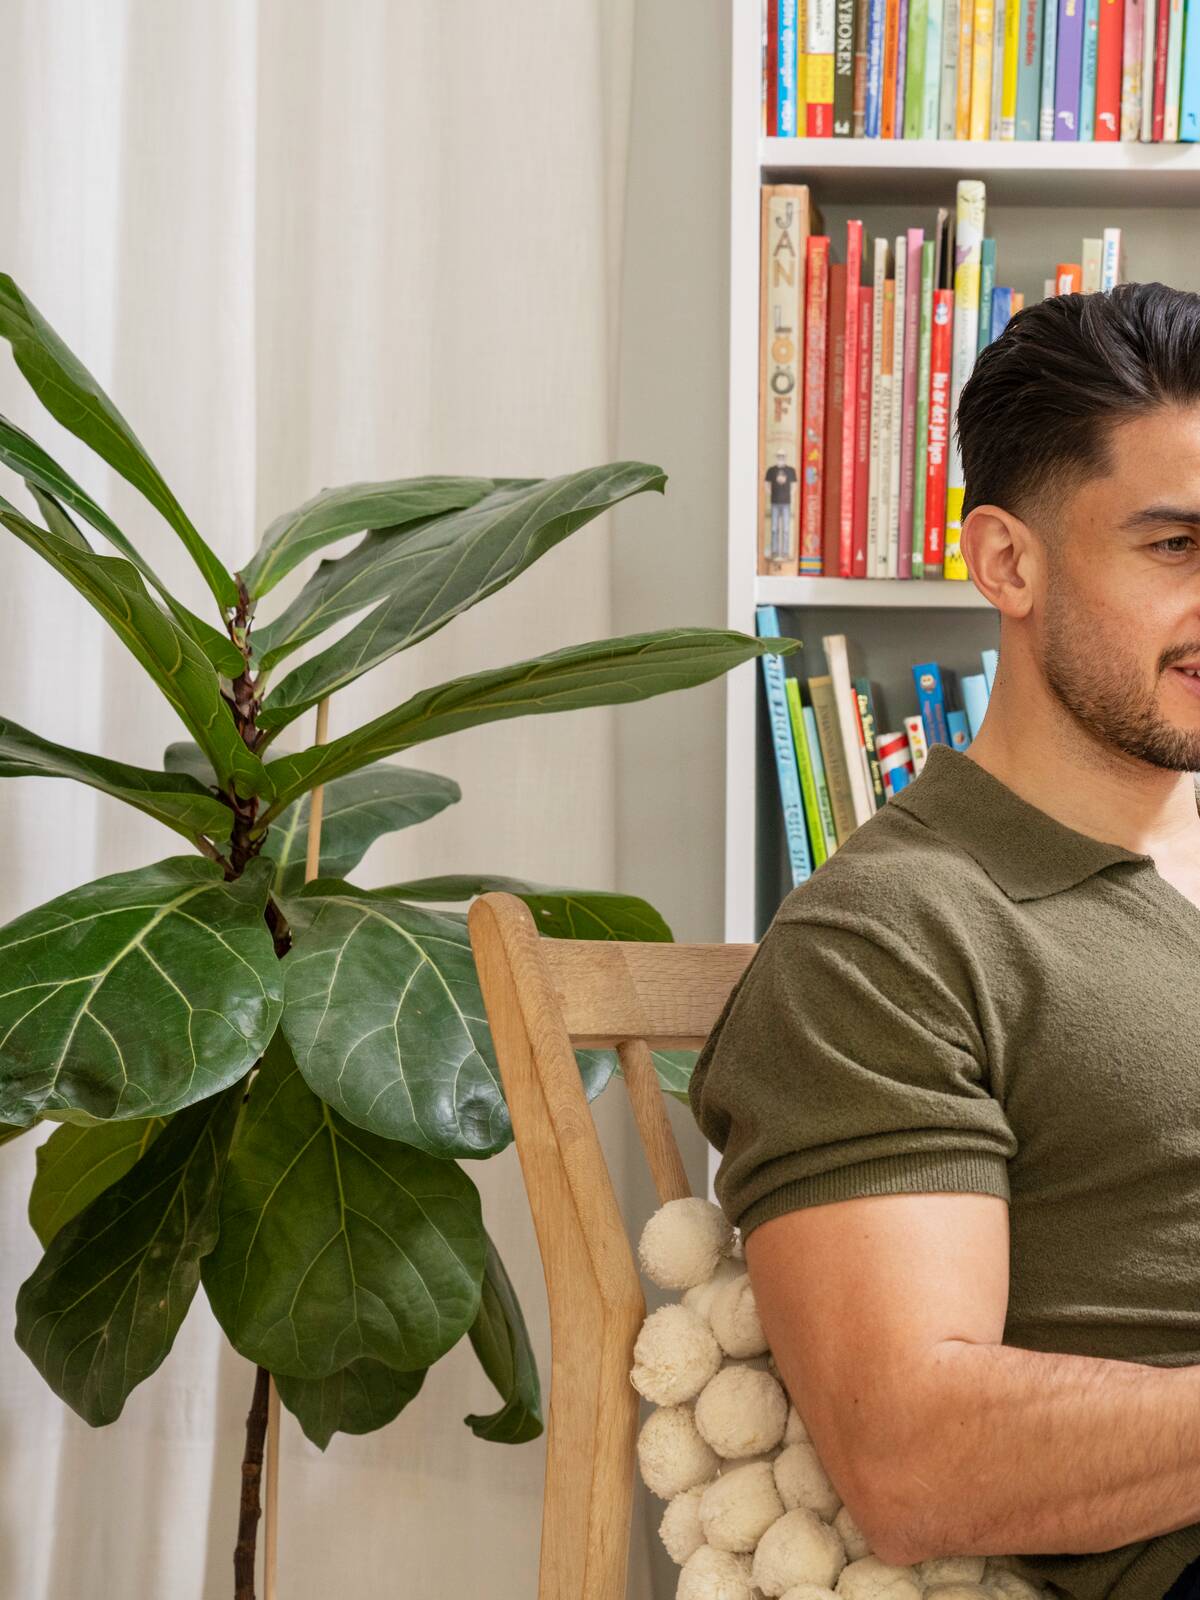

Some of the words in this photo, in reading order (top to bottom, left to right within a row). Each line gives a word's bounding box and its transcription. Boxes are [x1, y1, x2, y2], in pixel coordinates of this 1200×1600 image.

[836, 0, 854, 76] YBOKEN
[834, 120, 850, 135] 3
[772, 202, 796, 288] JAN
[931, 404, 946, 423] det
[928, 424, 946, 440] jul
